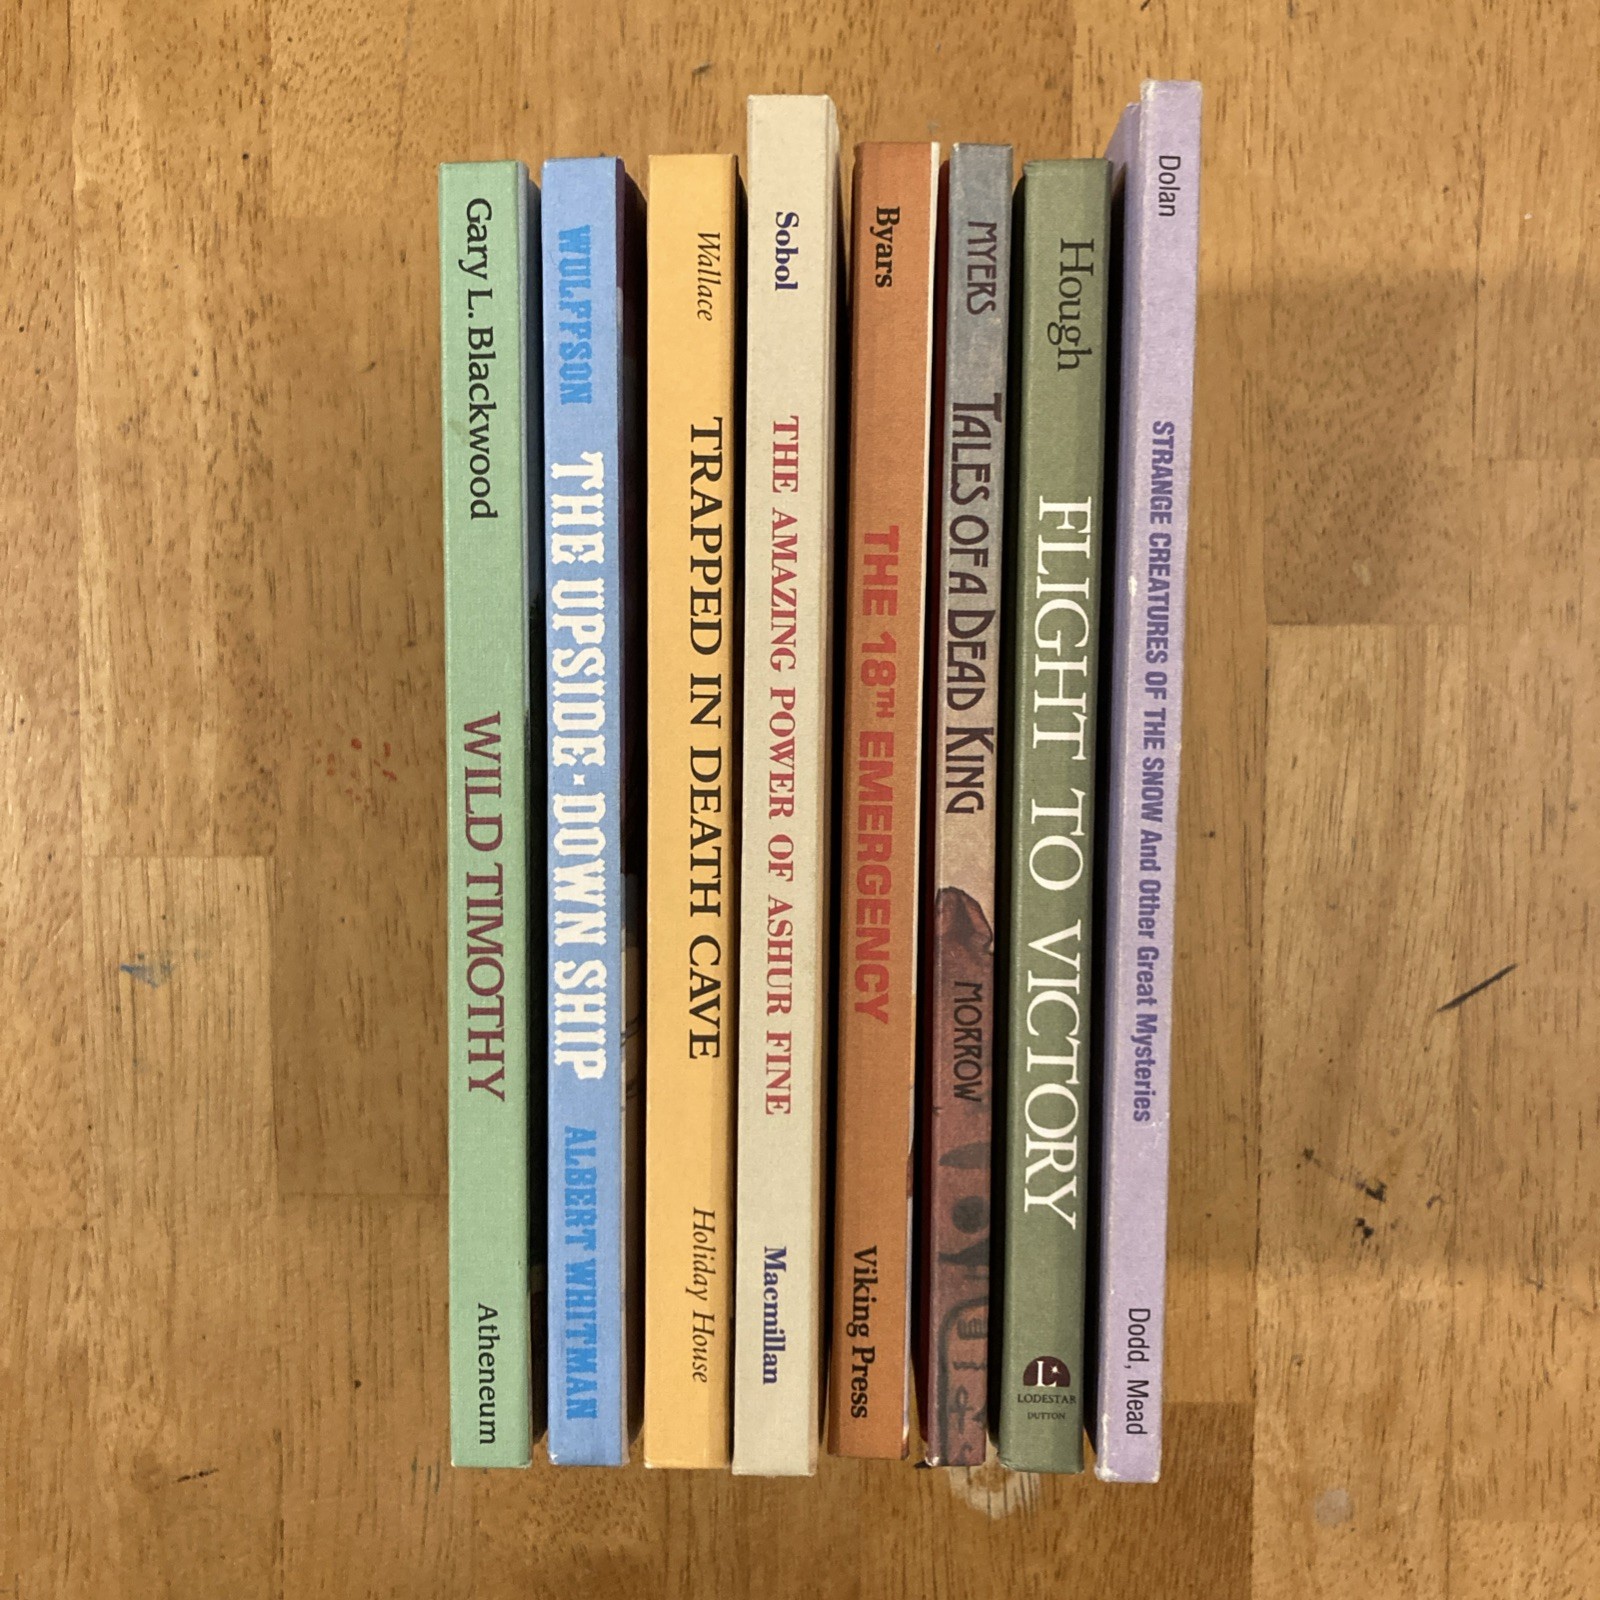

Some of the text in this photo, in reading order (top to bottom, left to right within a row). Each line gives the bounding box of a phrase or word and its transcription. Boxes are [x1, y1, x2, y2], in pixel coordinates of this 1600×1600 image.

[774, 211, 799, 291] Sobol
[870, 205, 900, 289] Byars
[1158, 155, 1181, 218] Dolan
[557, 223, 592, 406] WULFFSON
[695, 230, 721, 322] Wallace
[966, 221, 998, 315] MYERS
[1047, 238, 1095, 372] Hough
[460, 196, 498, 521] Gary L. Blackwood
[549, 450, 605, 565] THE
[861, 525, 900, 617] THE
[943, 393, 1003, 816] TALES OF A DEAD KING
[688, 416, 723, 1060] TRAPPED IN DEATH CAVE
[765, 415, 800, 1116] THE AMAZING POWER OF ASHUR FINE
[1131, 420, 1175, 1123] STRANGE CREATURES OF THE SNOW And Other Great Mysteries
[463, 710, 506, 1103] WILD TIMOTHY
[853, 731, 896, 1024] EMERGENCY
[1023, 496, 1093, 1230] FLIGHT TO VICTORY
[552, 960, 608, 1080] SHIP
[951, 980, 984, 1103] MORROW
[564, 1125, 597, 1421] ALBERT WHITMAN
[685, 1207, 716, 1384] Holiday House
[762, 1245, 787, 1386] Macmillan
[847, 1245, 878, 1420] Viking Press
[476, 1303, 500, 1446] Atheneum
[1017, 1393, 1077, 1405] LODESTAR
[1028, 1412, 1066, 1421] DUTTON
[1122, 1307, 1150, 1436] Dodd, Mead
